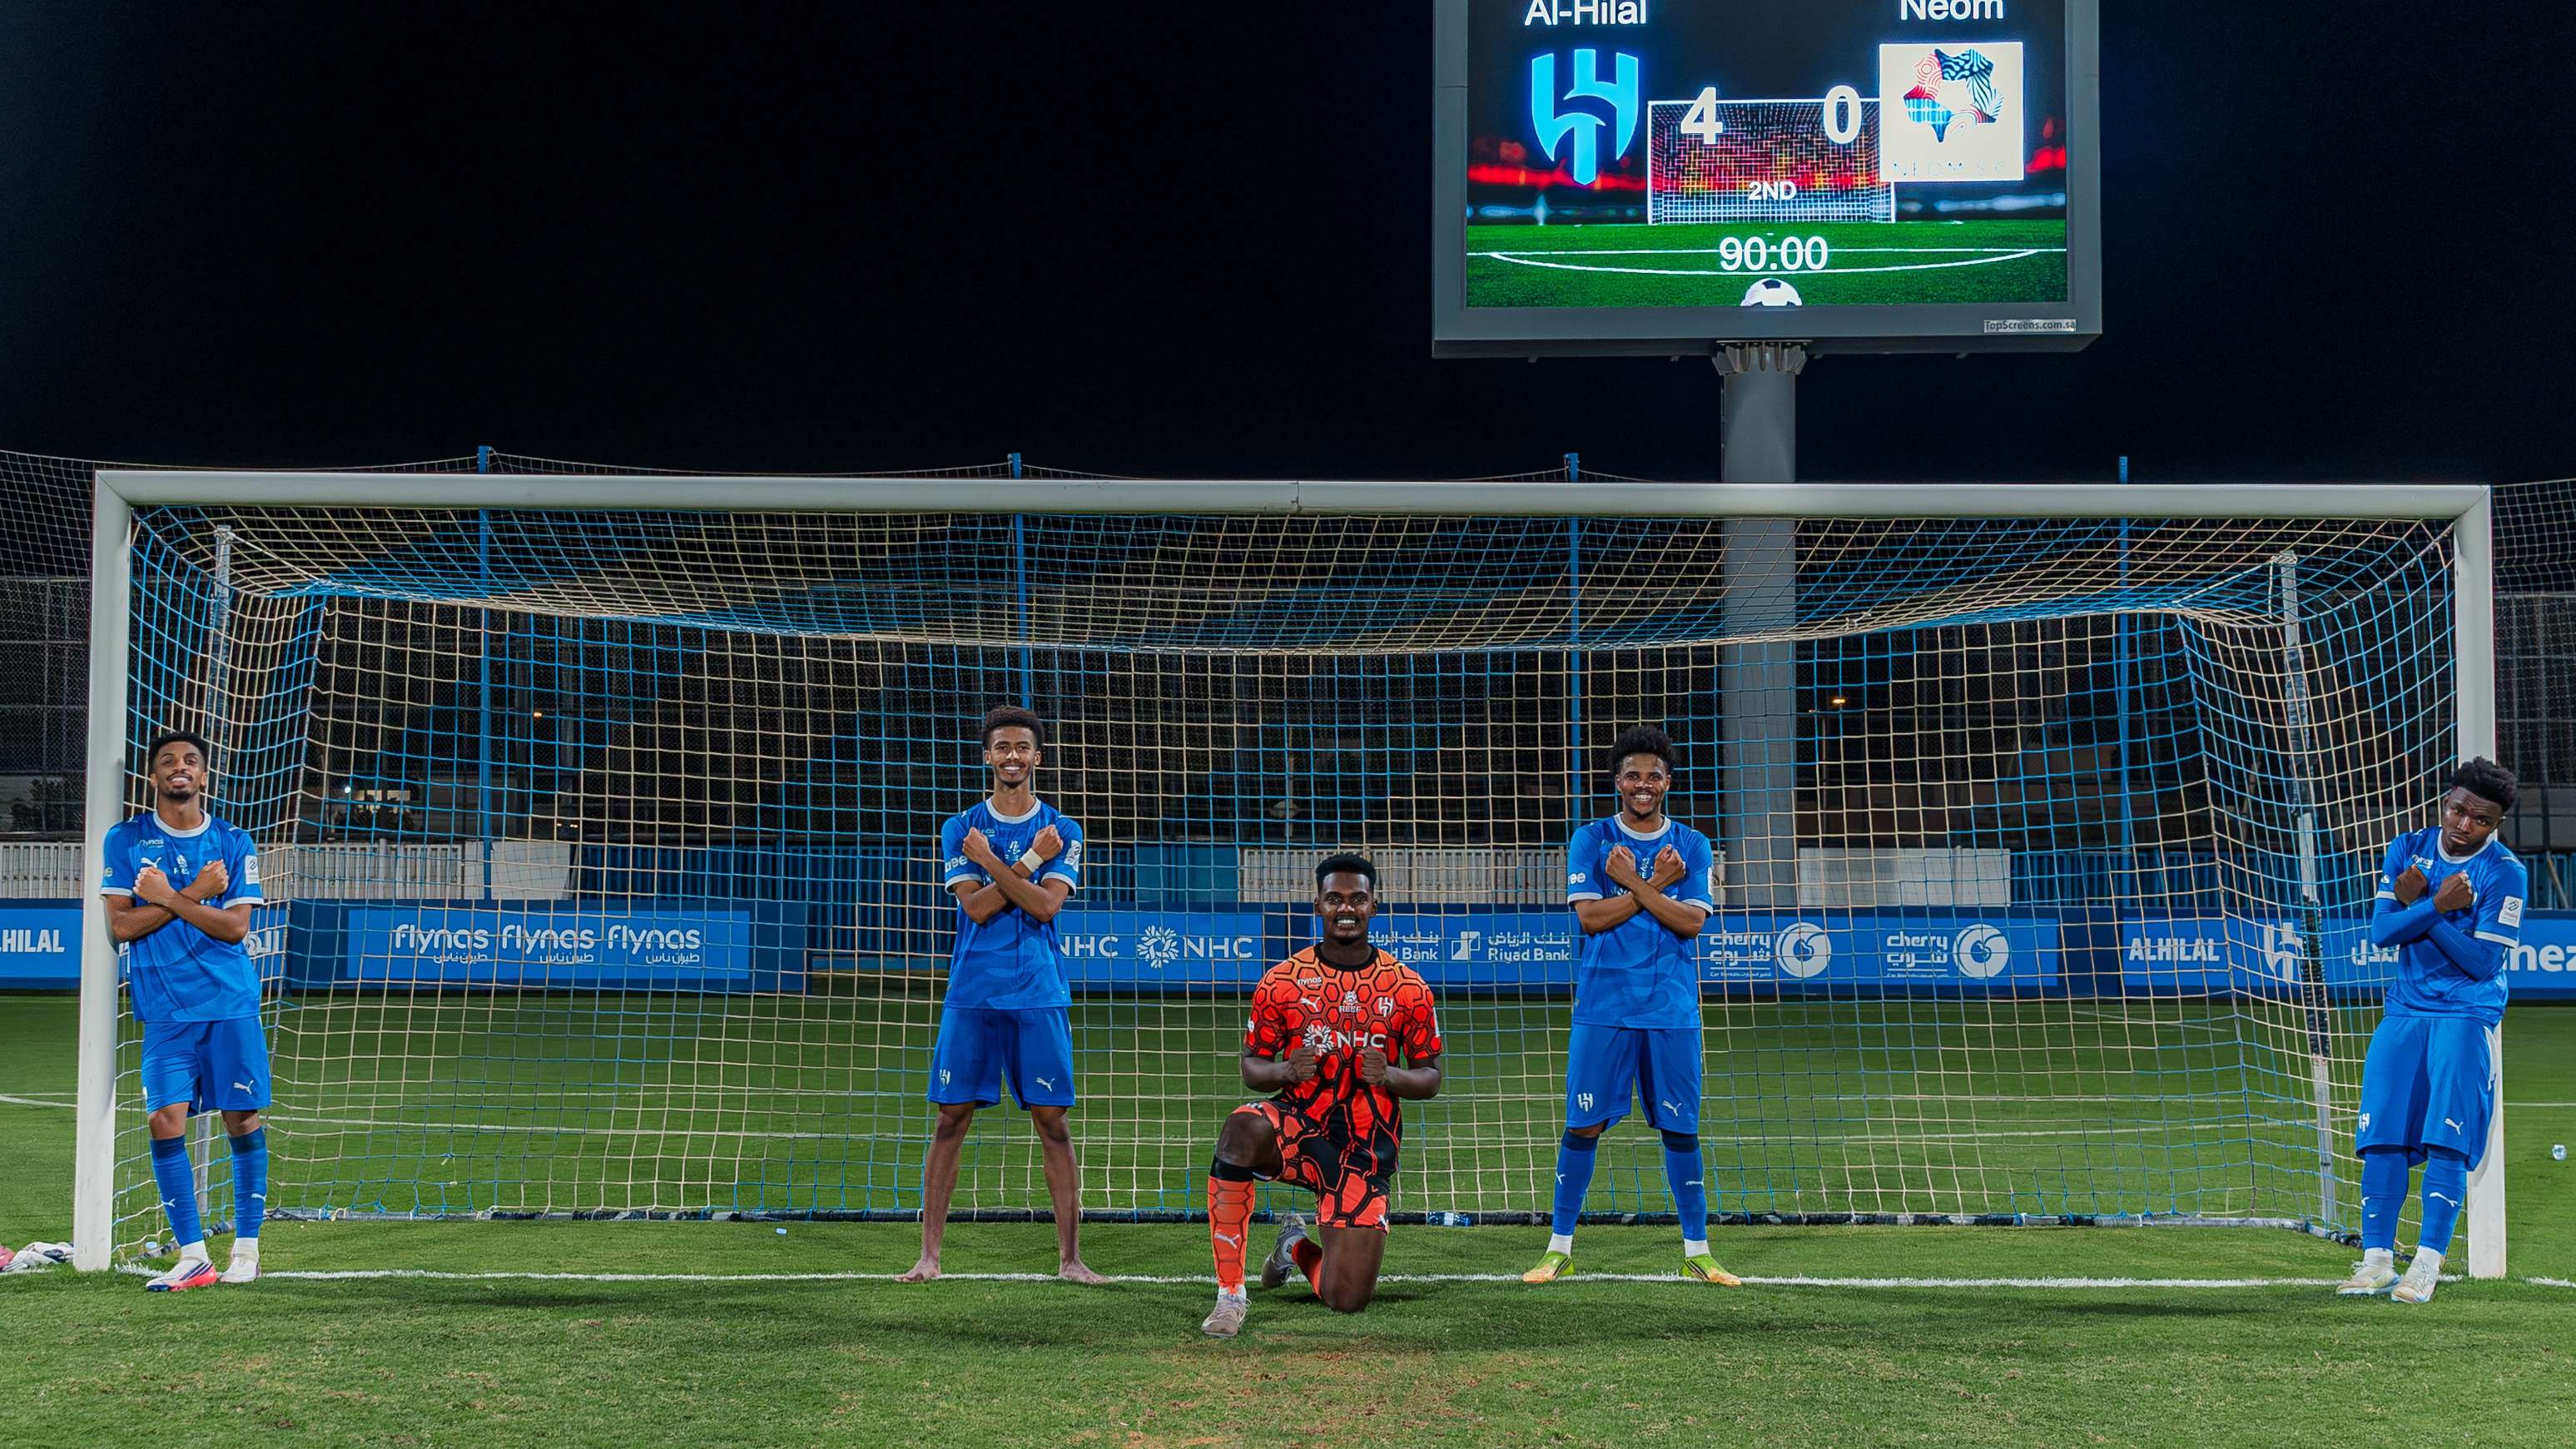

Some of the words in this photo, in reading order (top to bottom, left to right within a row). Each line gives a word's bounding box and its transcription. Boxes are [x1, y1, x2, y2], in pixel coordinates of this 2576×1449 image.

[1524, 0, 1647, 26] Al-Hilal
[1900, 0, 2004, 21] Neom
[1680, 87, 1723, 144] 4
[1824, 85, 1862, 144] 0
[1748, 181, 1797, 201] 2ND
[1719, 236, 1829, 271] 90:00
[0, 929, 66, 953] HILAL
[395, 924, 489, 954] flynas
[502, 925, 595, 955] flynas
[608, 925, 701, 955] flynas
[1184, 937, 1253, 958] NHC
[1710, 930, 1770, 949] cherry
[1887, 930, 1948, 950] cherry
[2129, 938, 2220, 961] ALHILAL
[1402, 947, 1438, 960] Bank
[1488, 948, 1530, 963] Riyad
[1534, 948, 1570, 961] Bank
[1337, 1031, 1387, 1049] NHC
